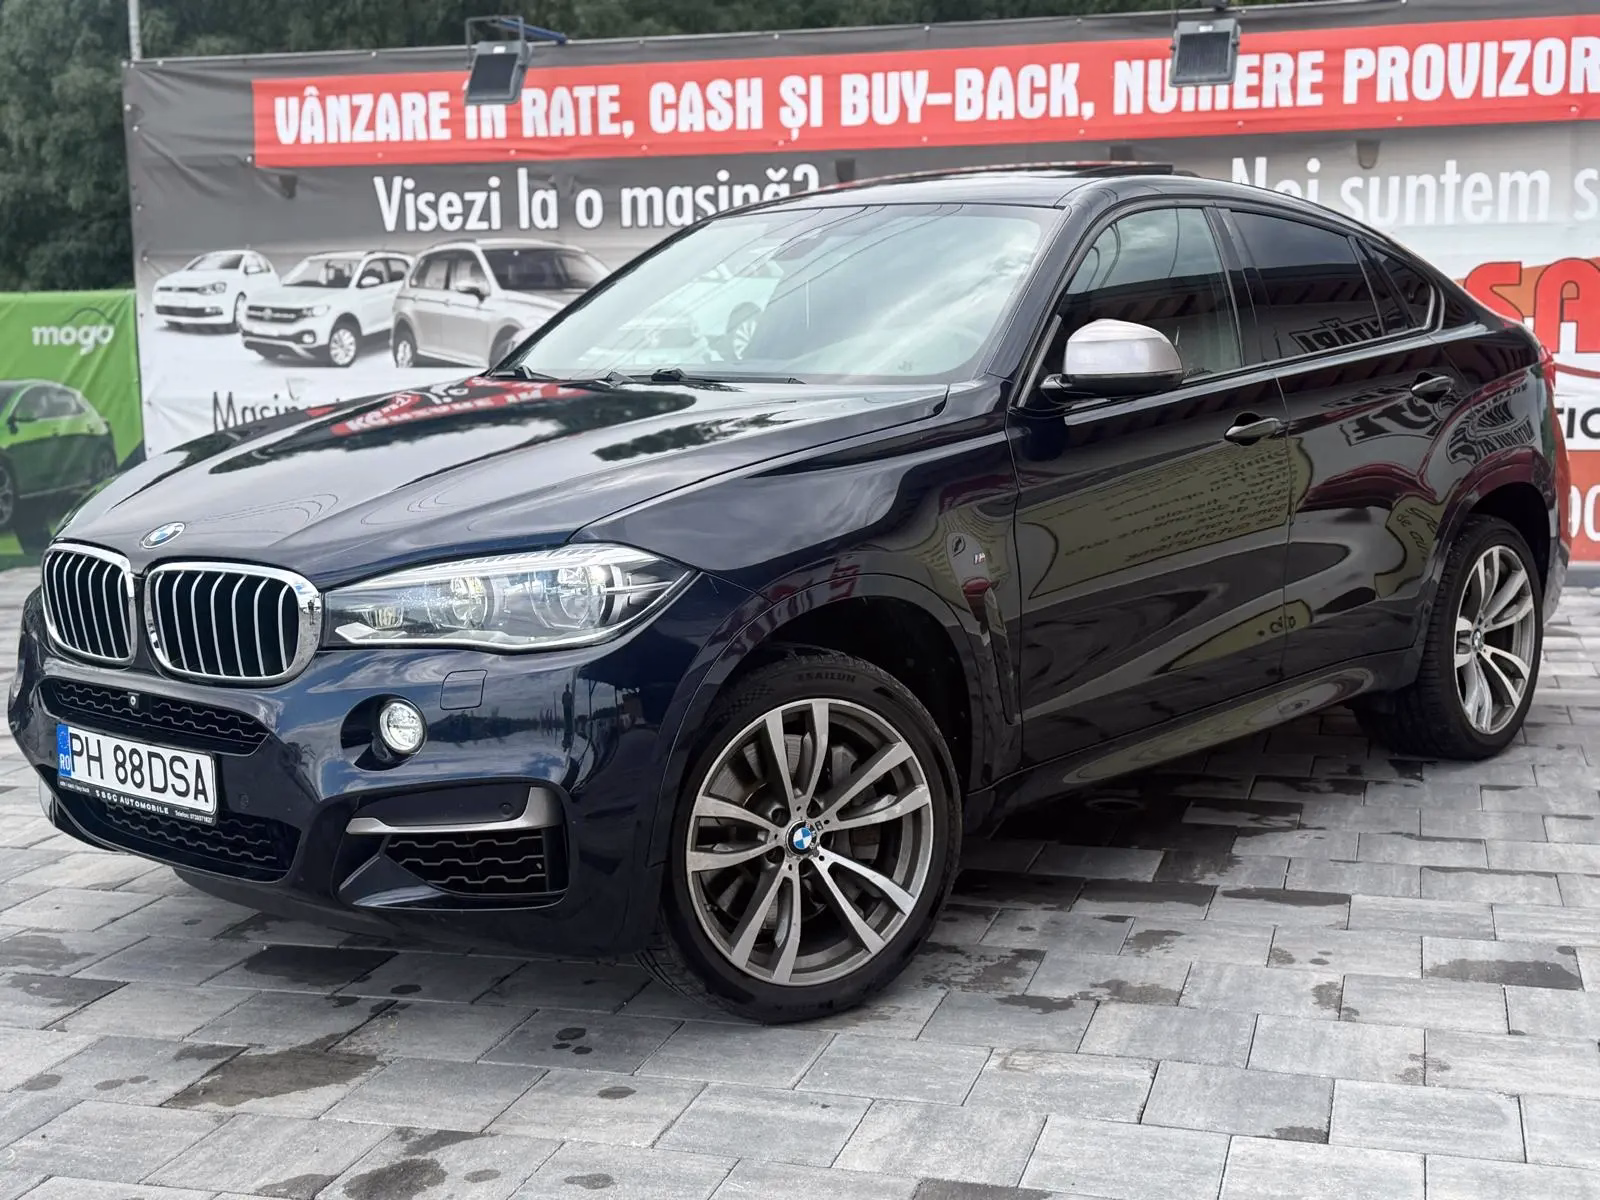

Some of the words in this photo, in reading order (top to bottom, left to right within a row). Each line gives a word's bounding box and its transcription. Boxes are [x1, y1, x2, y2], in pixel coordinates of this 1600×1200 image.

[274, 85, 452, 145] VÂNZARE
[521, 83, 635, 139] RATE,
[649, 77, 764, 135] CASH
[779, 74, 823, 142] ȘI
[840, 62, 1095, 127] BUY-BACK,
[1343, 35, 1600, 105] PROVIZOR
[373, 174, 502, 233] Visezi
[516, 167, 559, 230] la
[574, 188, 604, 230] o
[1340, 159, 1551, 226] suntem
[32, 323, 115, 356] mogo
[213, 390, 300, 434] Masi
[69, 732, 105, 781] PH
[119, 793, 170, 815] AUTOMOBILE
